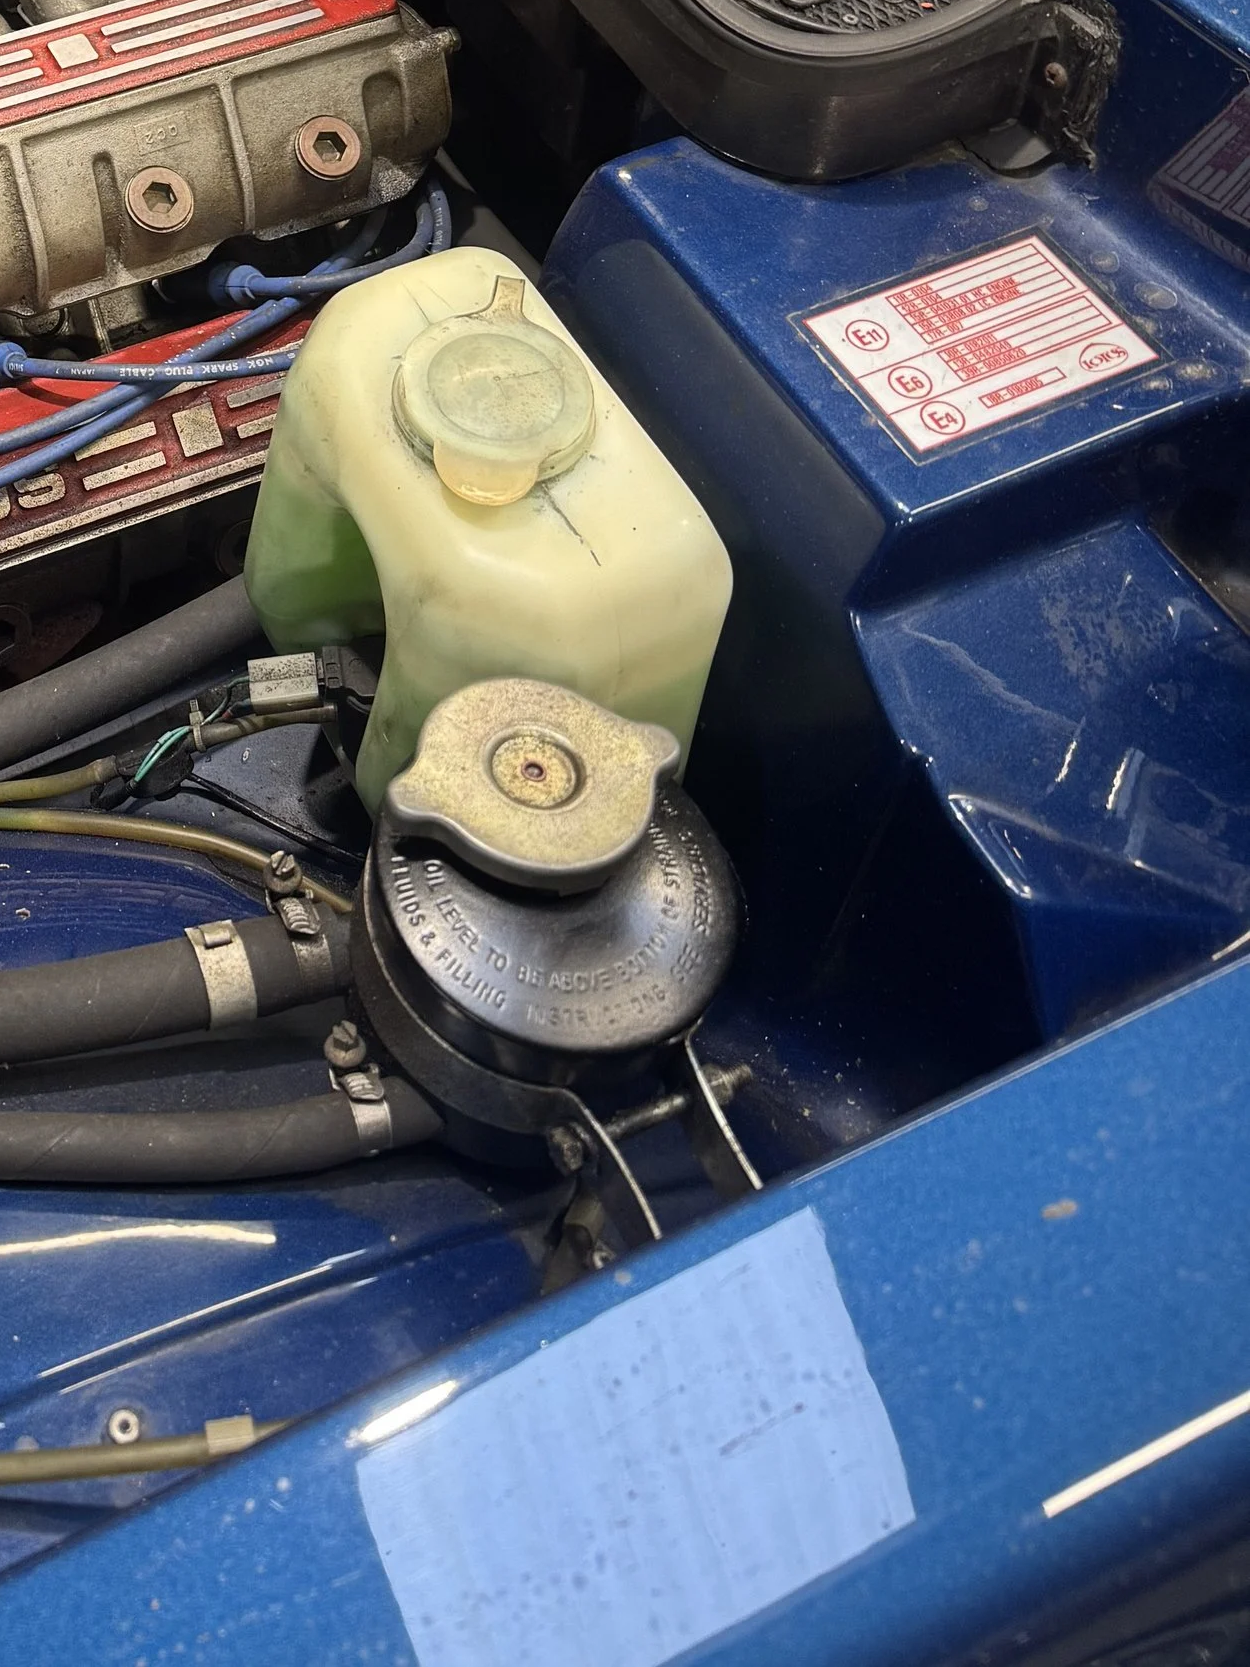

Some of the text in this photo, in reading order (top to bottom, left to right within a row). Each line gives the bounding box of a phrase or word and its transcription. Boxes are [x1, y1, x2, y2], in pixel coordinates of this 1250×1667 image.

[852, 328, 884, 347] E11
[119, 366, 156, 378] CABLE
[164, 366, 193, 377] PLUG
[201, 362, 239, 375] SPARK
[247, 357, 274, 370] NGK
[894, 375, 925, 393] E6
[927, 411, 959, 430] E4
[423, 859, 446, 893] OIL
[436, 894, 482, 954] LEVEL
[484, 946, 510, 973] TO
[517, 964, 545, 988] BE
[549, 967, 613, 994] ABOVE
[419, 931, 436, 948] &
[435, 948, 509, 1012] FILLING
[669, 940, 701, 983] SEE
